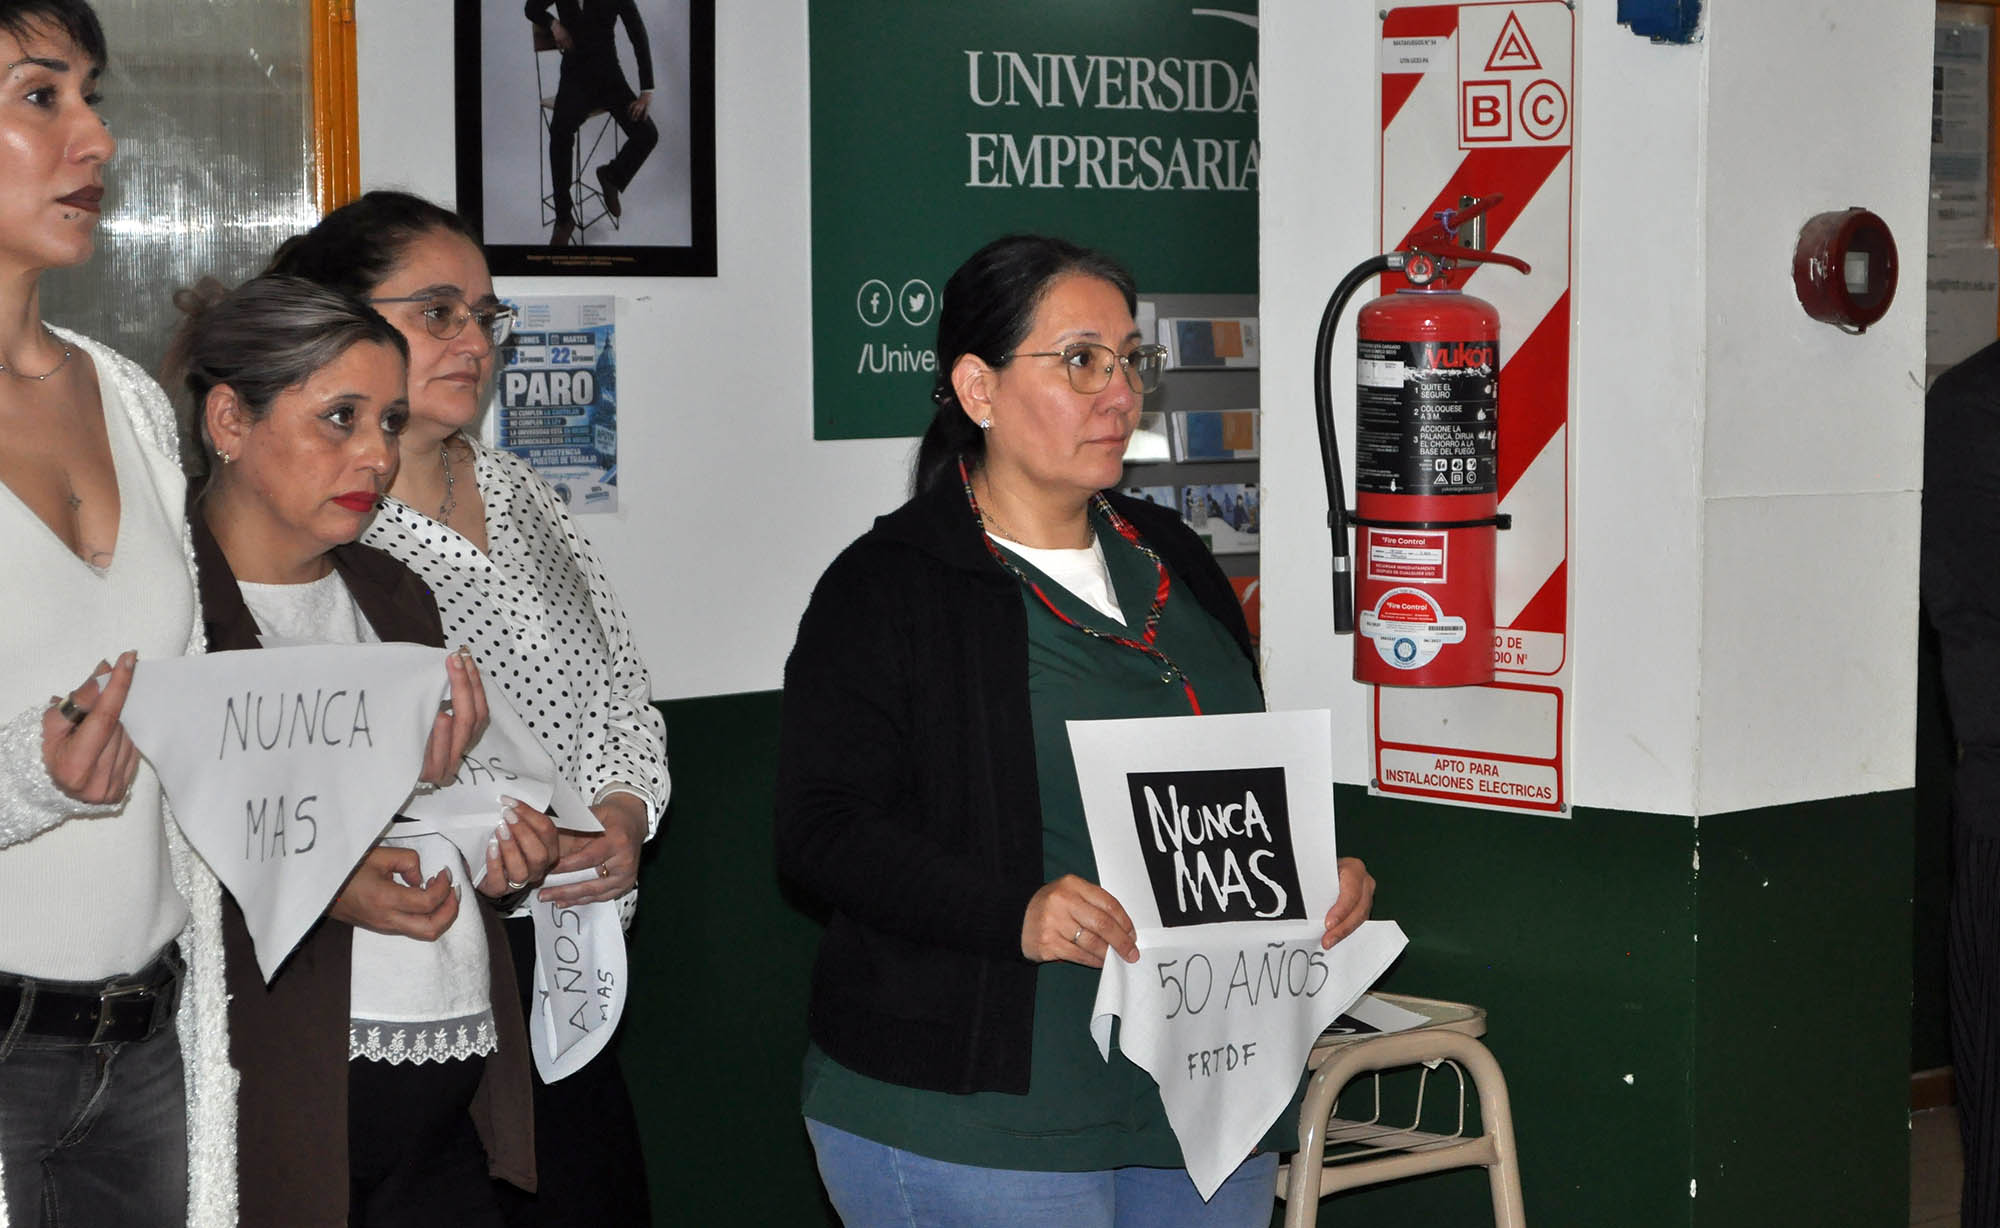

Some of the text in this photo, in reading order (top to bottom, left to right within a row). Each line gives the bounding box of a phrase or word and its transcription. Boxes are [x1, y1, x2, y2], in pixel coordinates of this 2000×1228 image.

[1499, 32, 1528, 60] A
[964, 50, 1259, 113] UNIVERSIDA
[1472, 95, 1502, 127] B
[1532, 95, 1554, 125] C
[966, 133, 1259, 191] EMPRESARIA
[552, 347, 571, 364] 22
[857, 343, 939, 374] /Unive
[506, 371, 594, 407] PARO
[1421, 383, 1442, 391] QUITE
[1443, 383, 1452, 391] EL
[1421, 391, 1451, 399] SEGURO
[1414, 404, 1463, 416] 2 COLOQUESE
[1413, 436, 1419, 444] 3
[1420, 425, 1462, 433] ACCIONE LA
[1420, 440, 1429, 448] EL
[1430, 440, 1460, 448] CHORRO
[1420, 447, 1476, 455] BASE DEL FUEGO
[1507, 636, 1522, 649] DE
[220, 689, 373, 760] NUNCA
[1434, 758, 1500, 777] APTO PARA
[1386, 768, 1552, 800] INSTALACIONES ELECTRICAS
[245, 796, 317, 862] MAS
[1144, 785, 1272, 852] NUNCA
[1174, 848, 1288, 918] MAS
[1157, 941, 1329, 1019] 50 AÑOS
[1188, 1043, 1257, 1080] FRTDF
